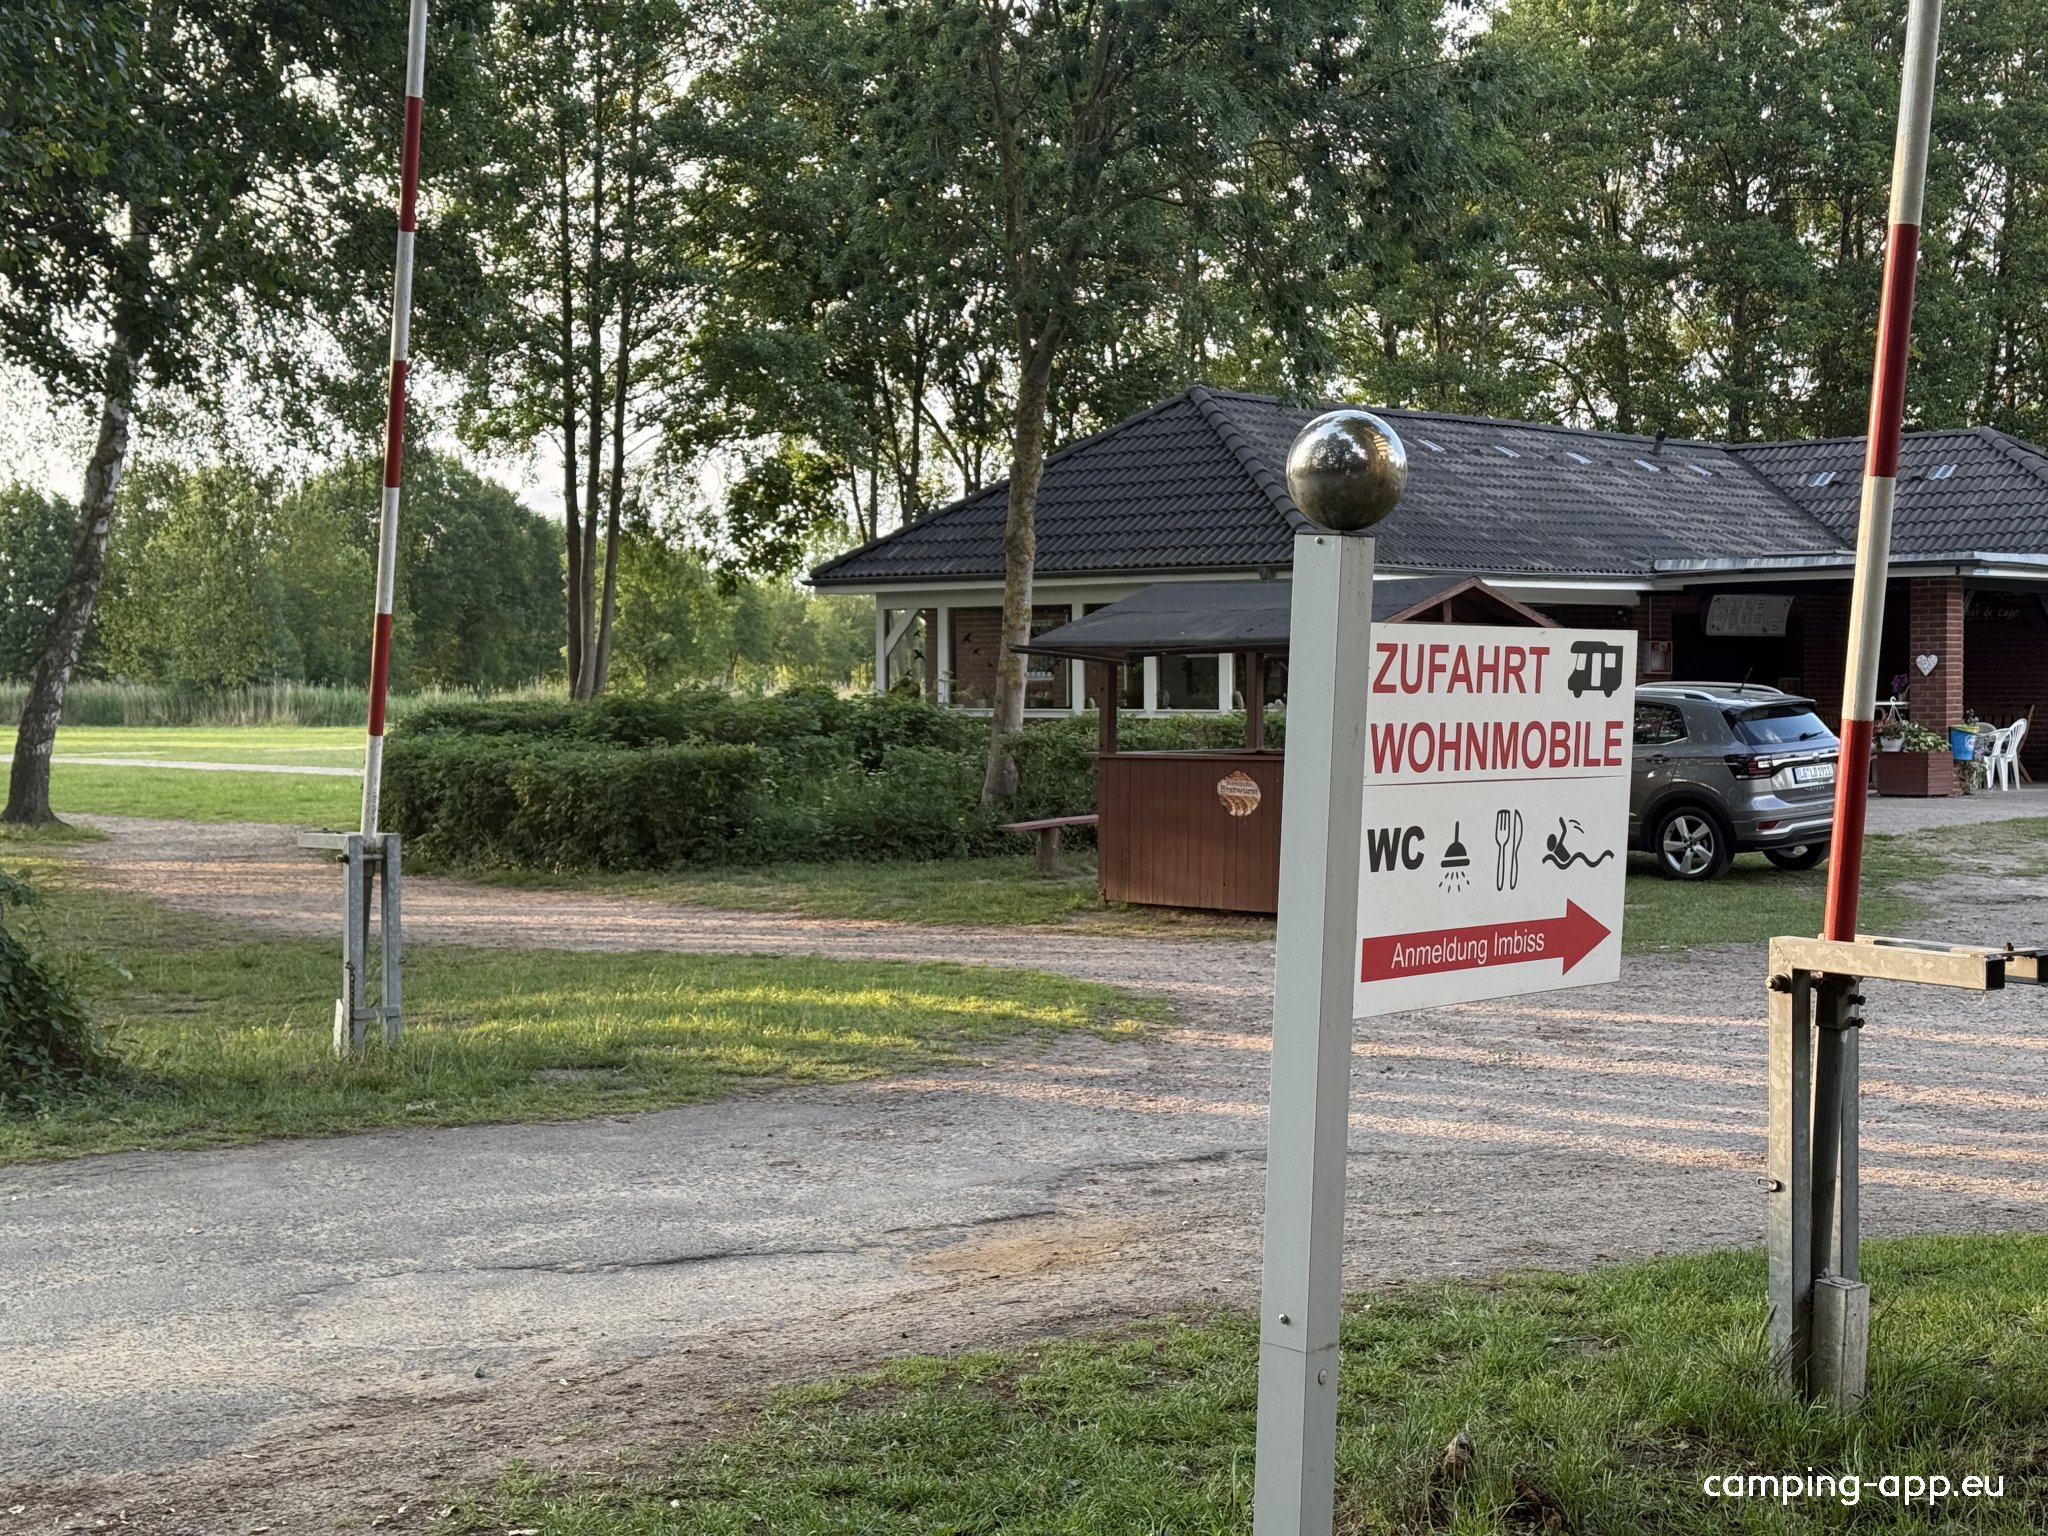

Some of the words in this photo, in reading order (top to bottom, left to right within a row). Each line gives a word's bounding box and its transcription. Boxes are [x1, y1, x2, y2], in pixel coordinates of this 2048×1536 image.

[1372, 642, 1550, 694] ZUFAHRT
[1370, 720, 1624, 774] WOHNMOBILE
[1220, 783, 1258, 795] Bratwurst
[1367, 825, 1425, 873] WC
[1391, 937, 1488, 969] Anmeldung
[1493, 929, 1545, 957] Imbiss
